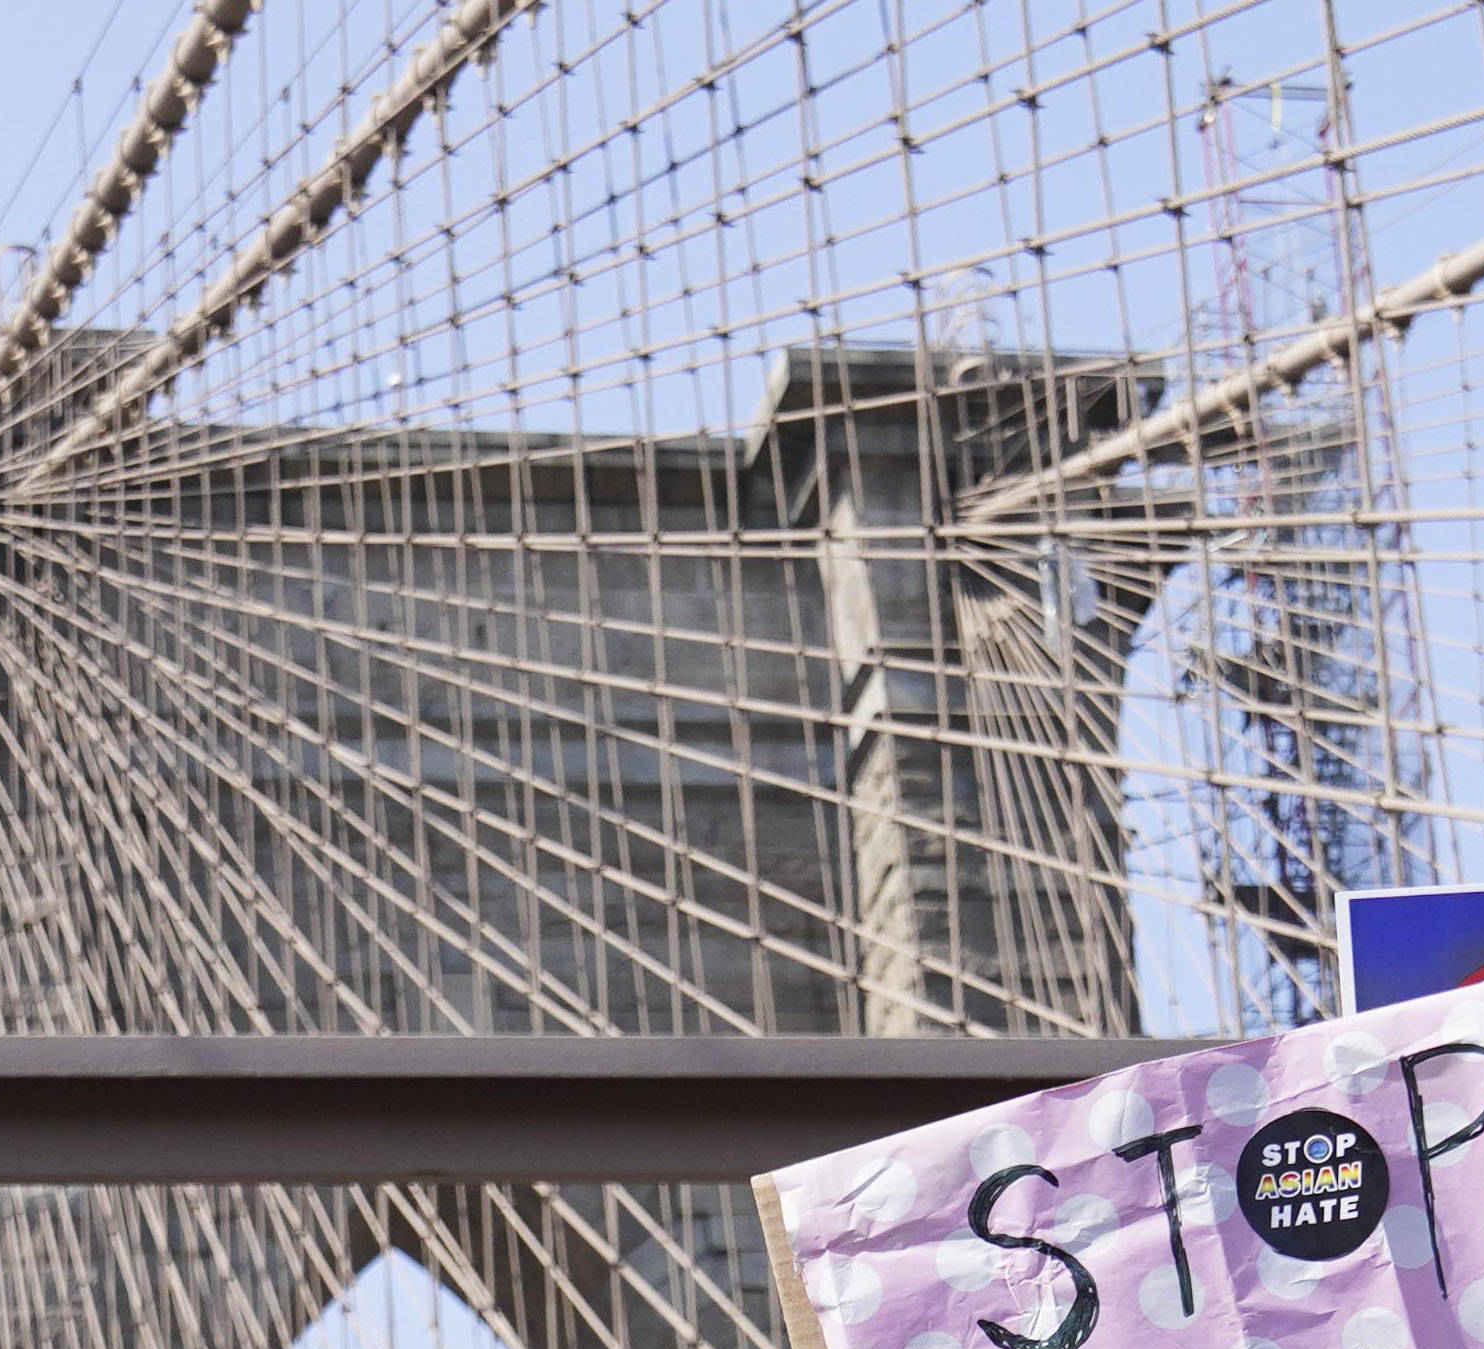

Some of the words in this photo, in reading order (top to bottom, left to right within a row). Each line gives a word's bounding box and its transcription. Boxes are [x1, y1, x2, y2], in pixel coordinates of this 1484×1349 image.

[1261, 1132, 1357, 1168] STOP
[1254, 1160, 1363, 1201] ASIAN
[1269, 1194, 1360, 1230] HATE
